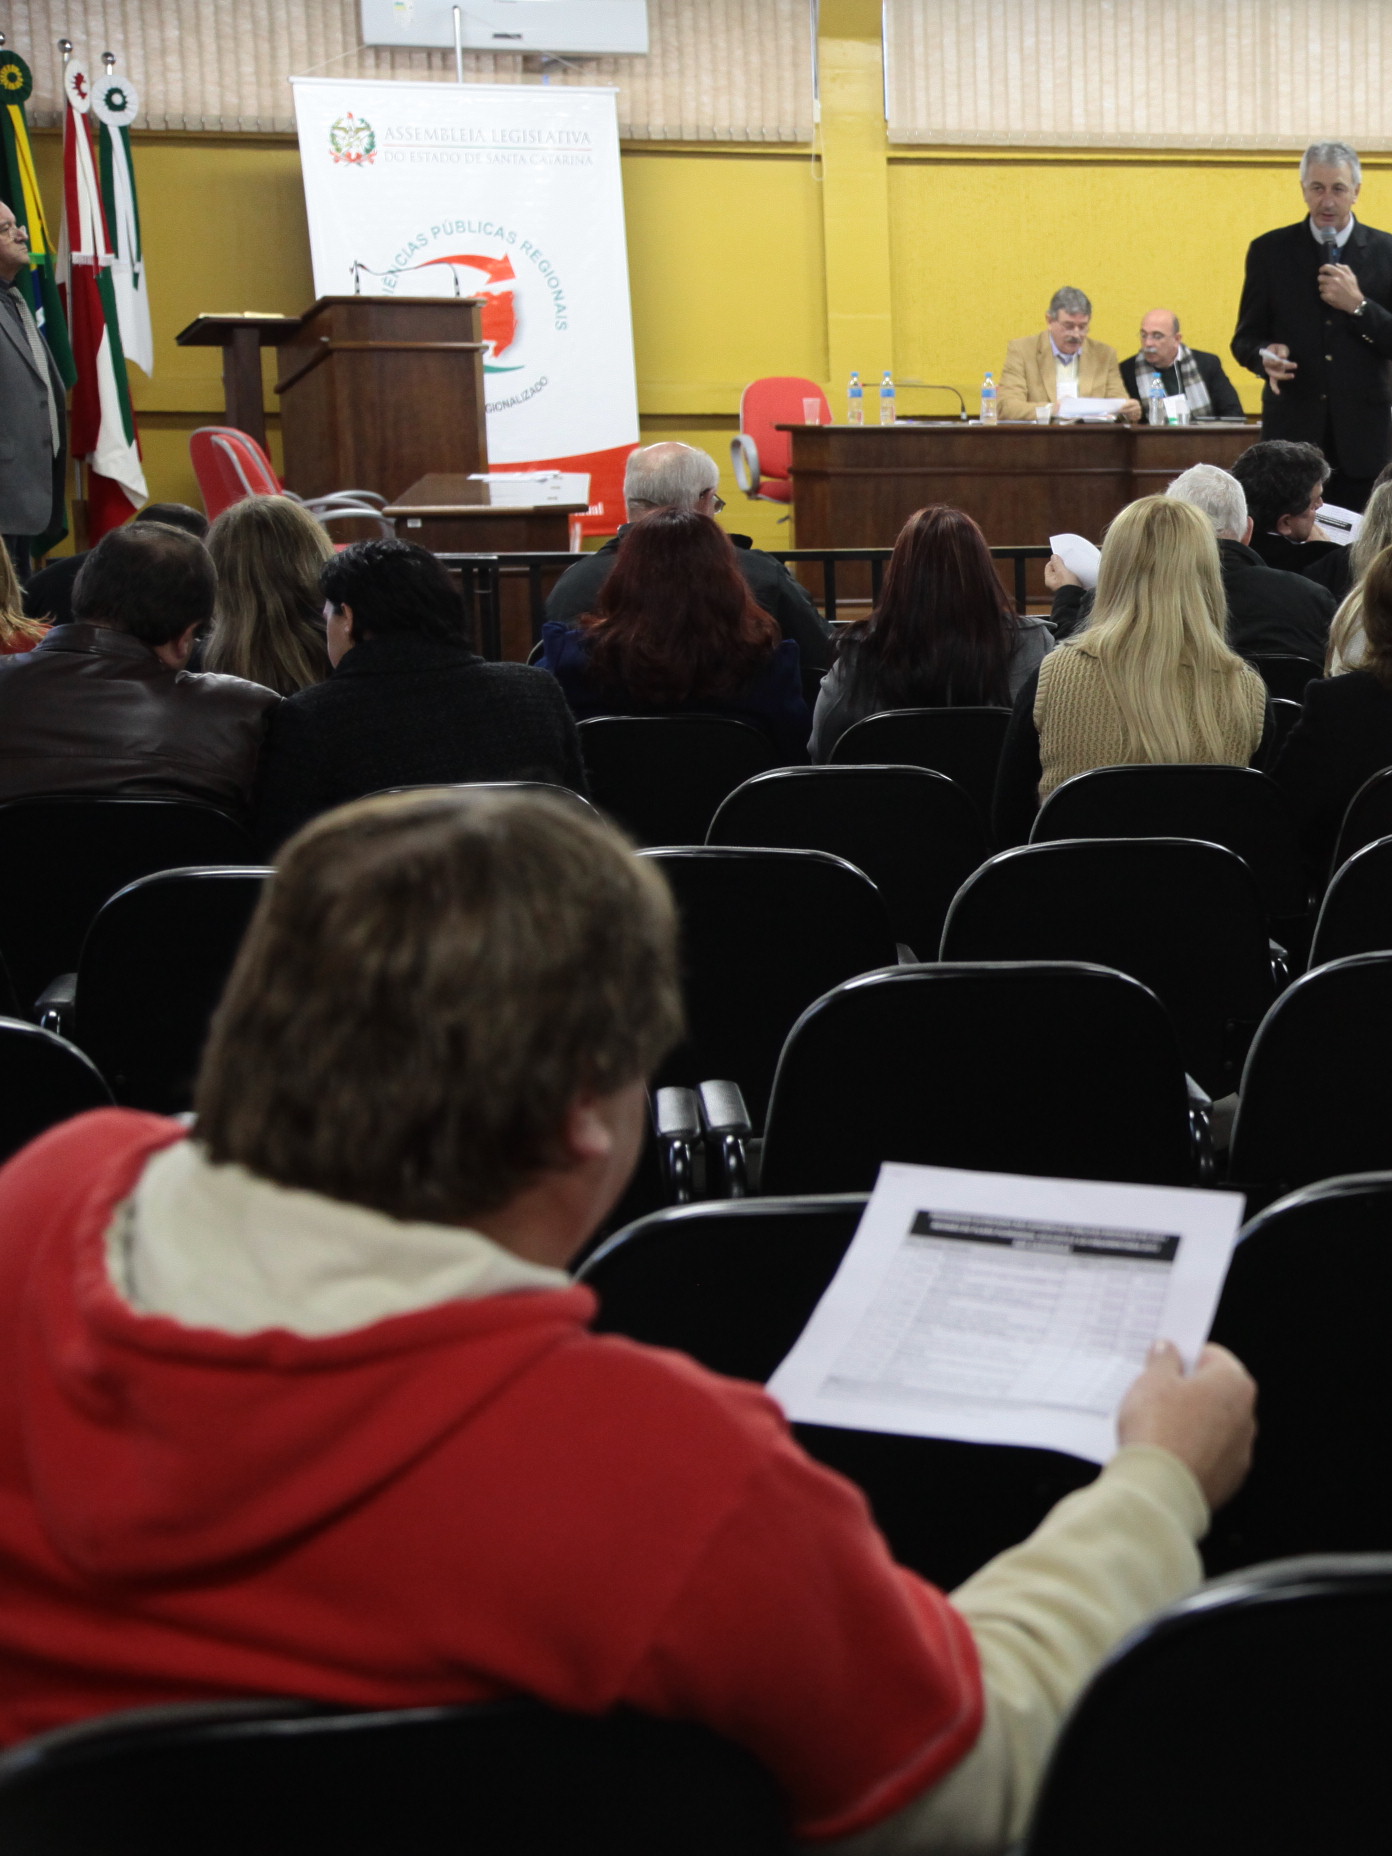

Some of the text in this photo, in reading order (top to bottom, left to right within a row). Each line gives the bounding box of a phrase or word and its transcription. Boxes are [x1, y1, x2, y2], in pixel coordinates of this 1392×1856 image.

[384, 126, 592, 145] ASSEMBLEIA LEGISLATIVA
[383, 151, 593, 166] DO ESTADO DE SANTA CATARINA
[382, 219, 567, 331] IÊNCIAS PÚBLICAS REGIONAIS
[485, 376, 548, 413] GIONALIZADO
